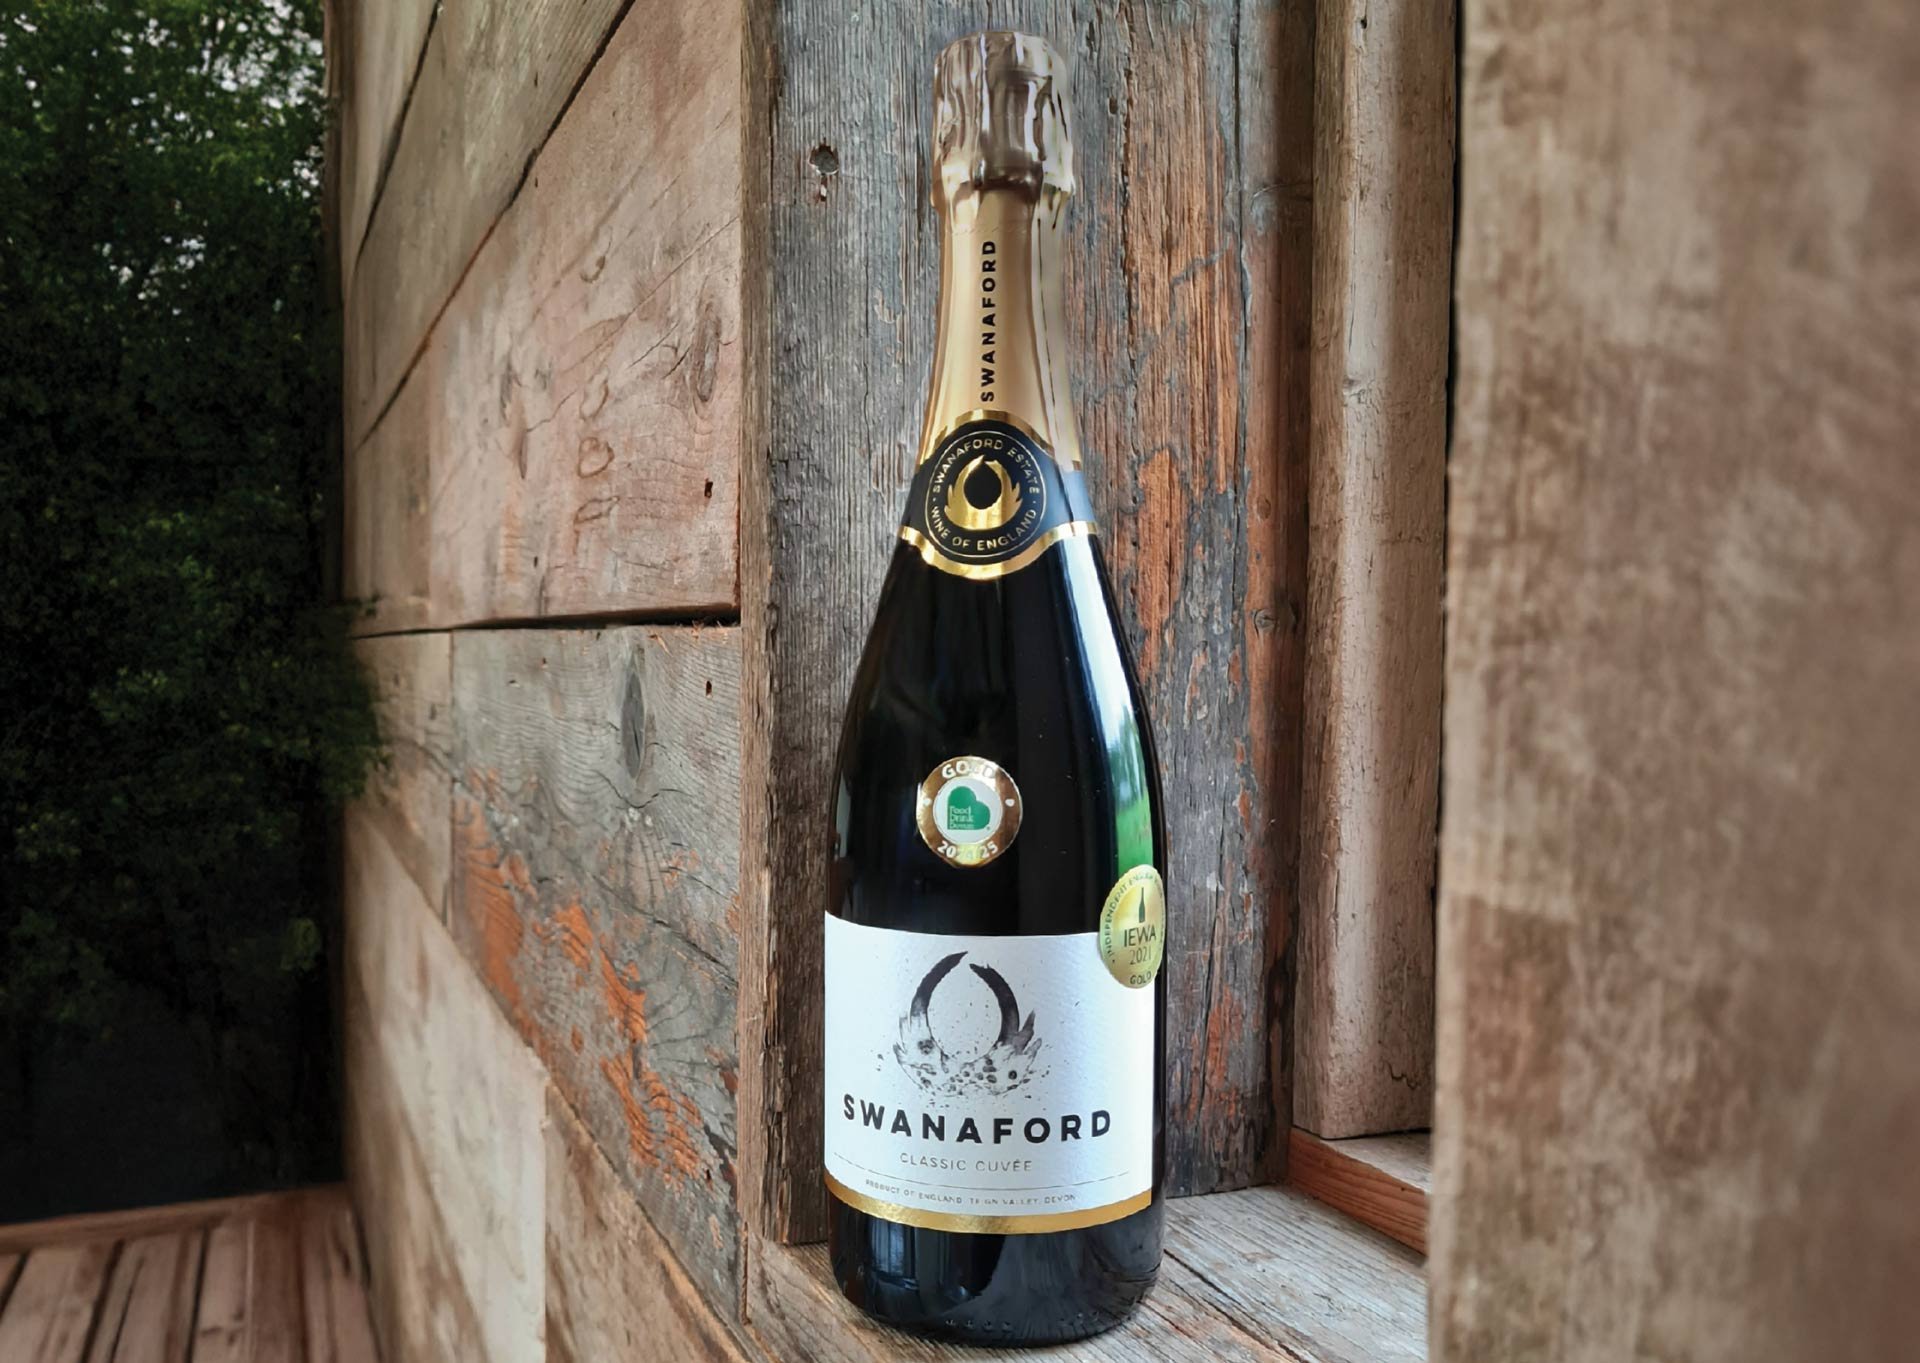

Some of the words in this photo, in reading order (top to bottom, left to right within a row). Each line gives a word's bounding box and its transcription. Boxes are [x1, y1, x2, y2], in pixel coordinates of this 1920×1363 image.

[980, 240, 996, 402] SWANAFORD
[932, 438, 1003, 493] SWANAFORD
[1007, 447, 1040, 494] ESTATE
[931, 506, 951, 539] WINE
[952, 536, 971, 549] OF
[977, 509, 1037, 551] ENGLAND
[1124, 923, 1157, 947] IEWA
[1129, 946, 1152, 965] 2021
[1129, 970, 1152, 985] GOLD
[843, 1094, 1111, 1145] SWANAFORD
[899, 1152, 967, 1171] CLASSIC
[975, 1158, 1033, 1172] CUVÉE
[865, 1178, 900, 1194] PRODUCT
[903, 1188, 915, 1197] OF
[918, 1192, 963, 1204] ENGLAND
[969, 1197, 998, 1205] TEGN
